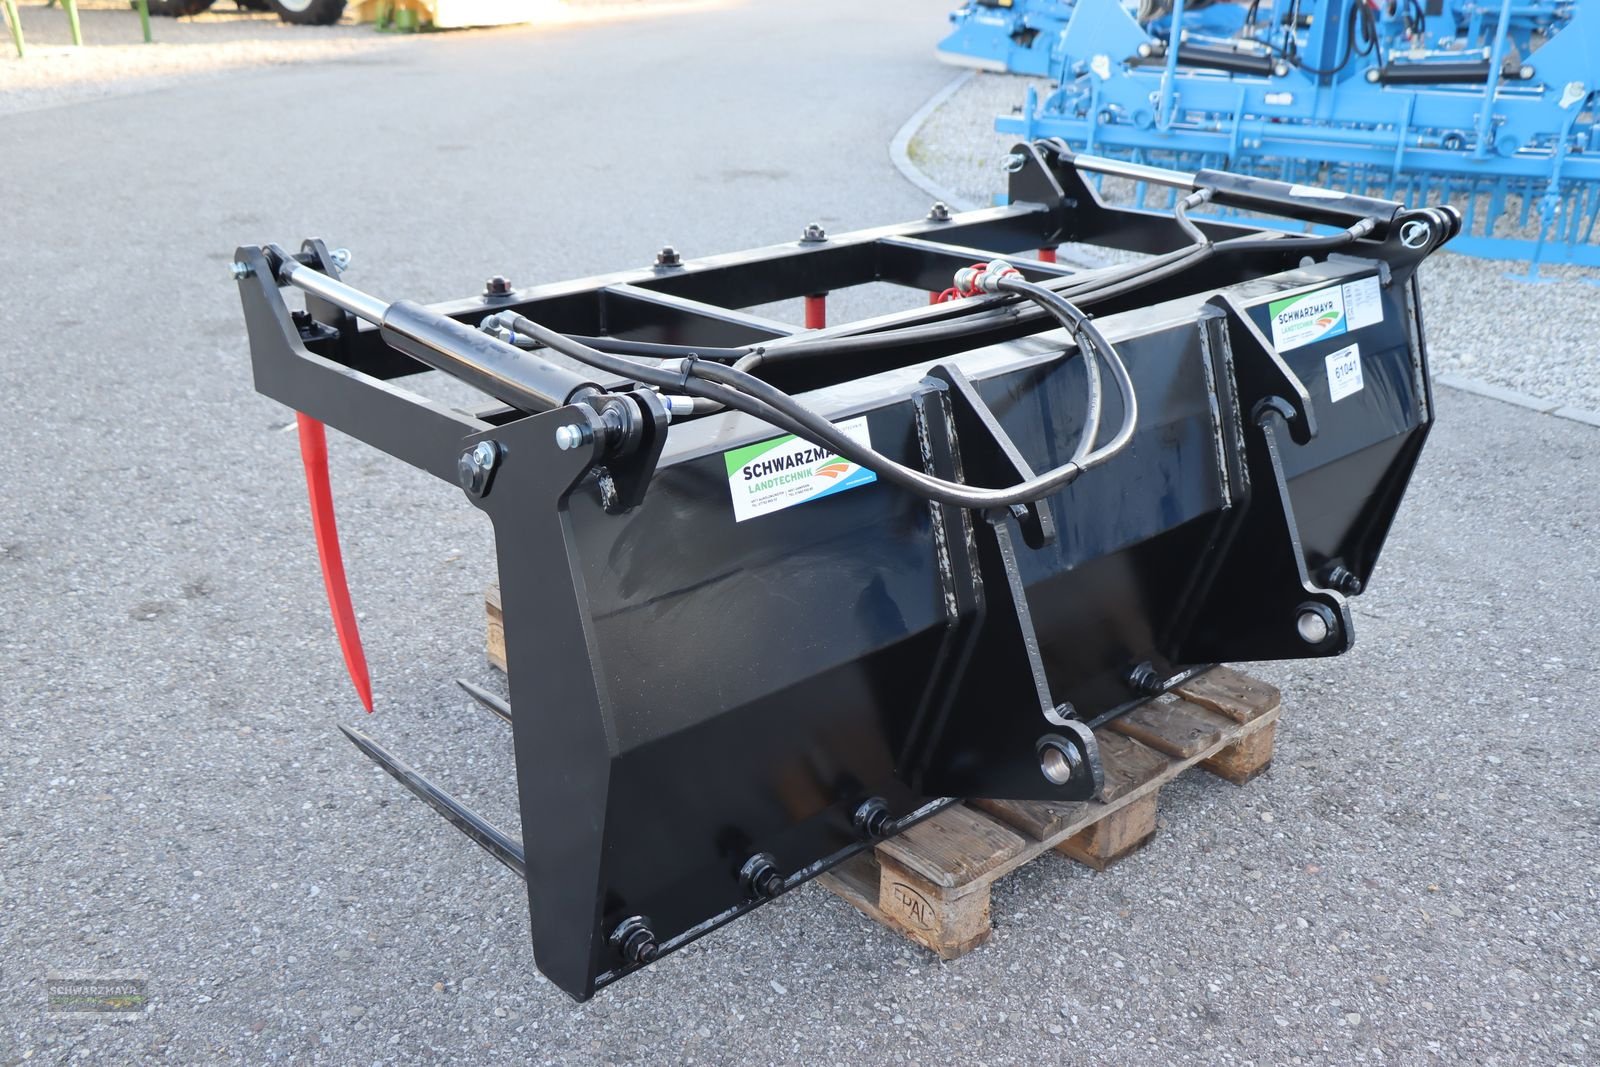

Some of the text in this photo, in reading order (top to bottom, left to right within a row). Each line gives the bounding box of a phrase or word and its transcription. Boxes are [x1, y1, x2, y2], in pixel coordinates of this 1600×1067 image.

[1278, 300, 1334, 325] SCHWARZMAYR
[1335, 360, 1357, 379] 61041
[743, 447, 835, 480] SCHWARZMA
[748, 468, 813, 494] LANDTECHNIK
